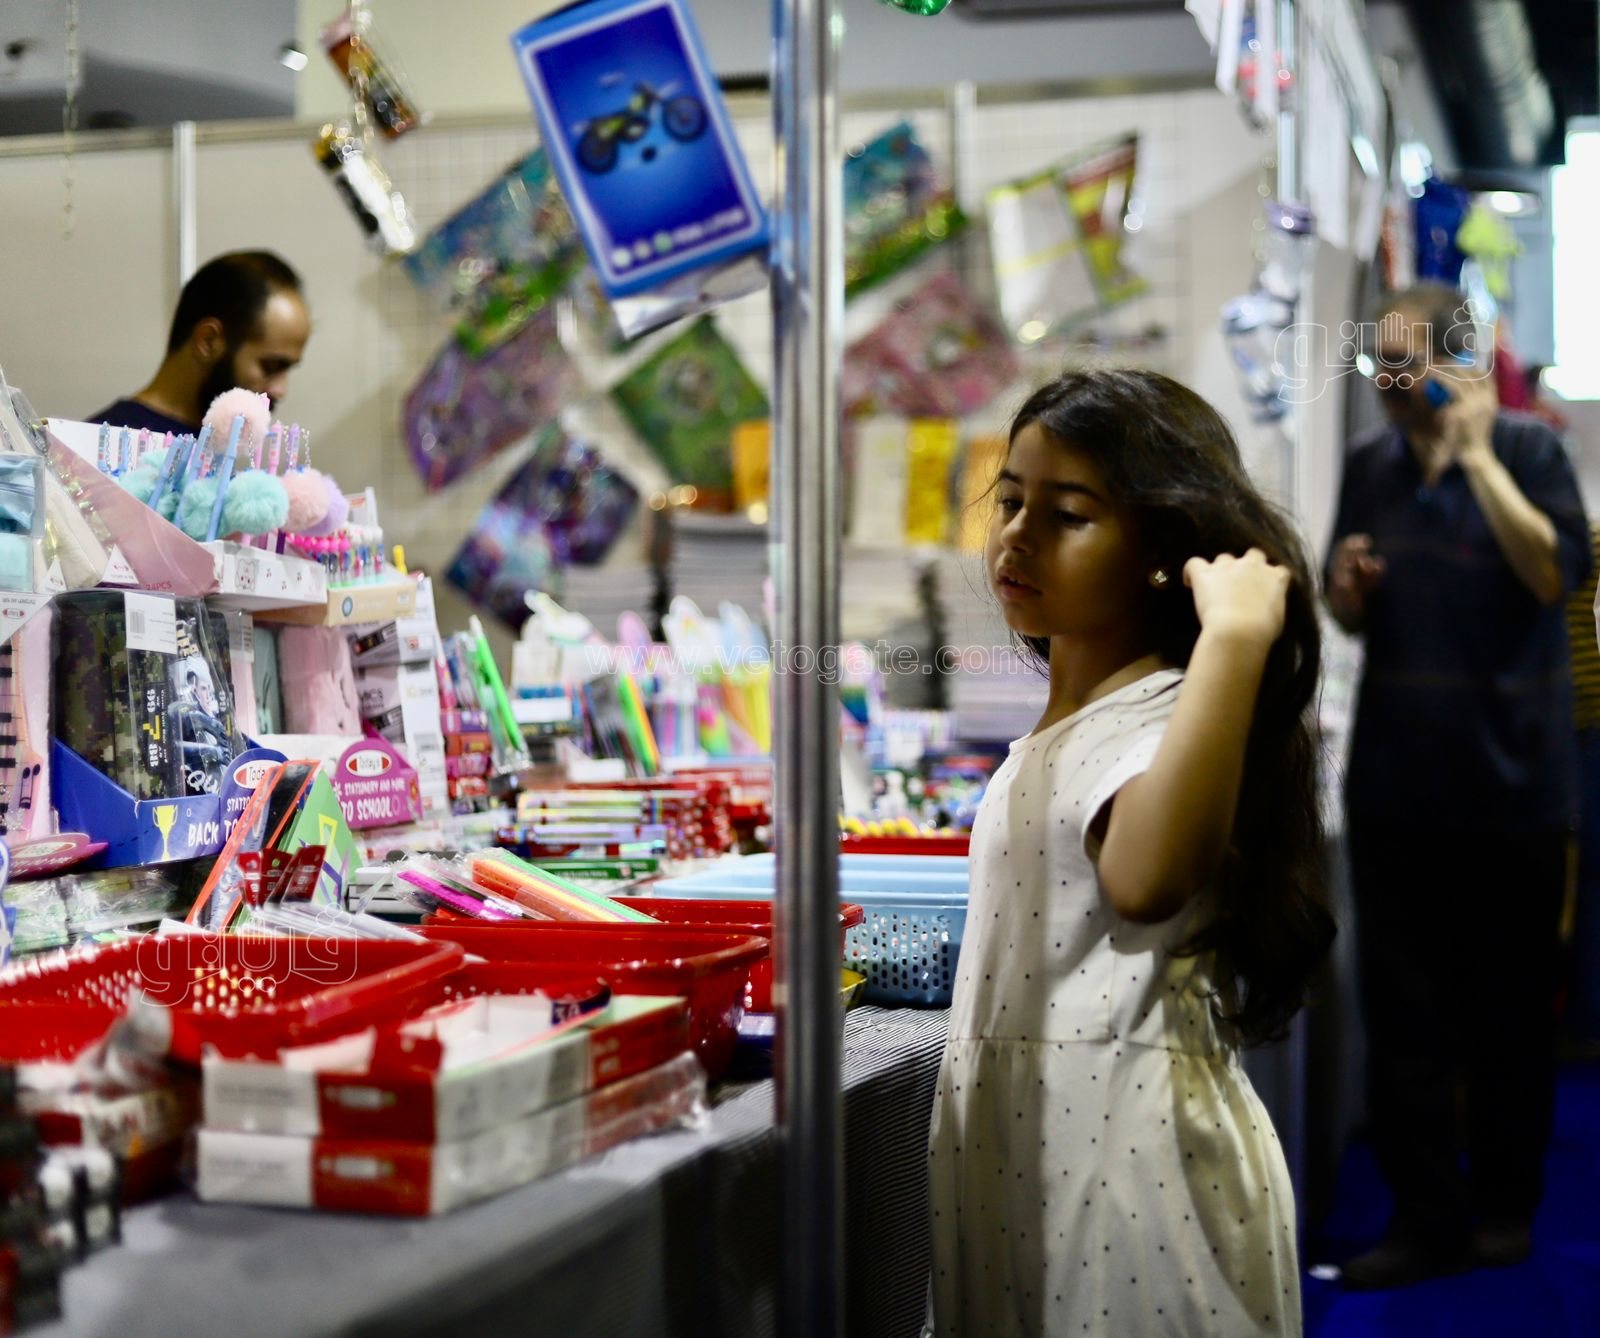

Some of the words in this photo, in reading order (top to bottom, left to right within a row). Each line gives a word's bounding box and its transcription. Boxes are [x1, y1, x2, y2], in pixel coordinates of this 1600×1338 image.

[340, 799, 354, 822] TO
[356, 795, 393, 821] SCHOOL
[188, 820, 219, 848] BACK
